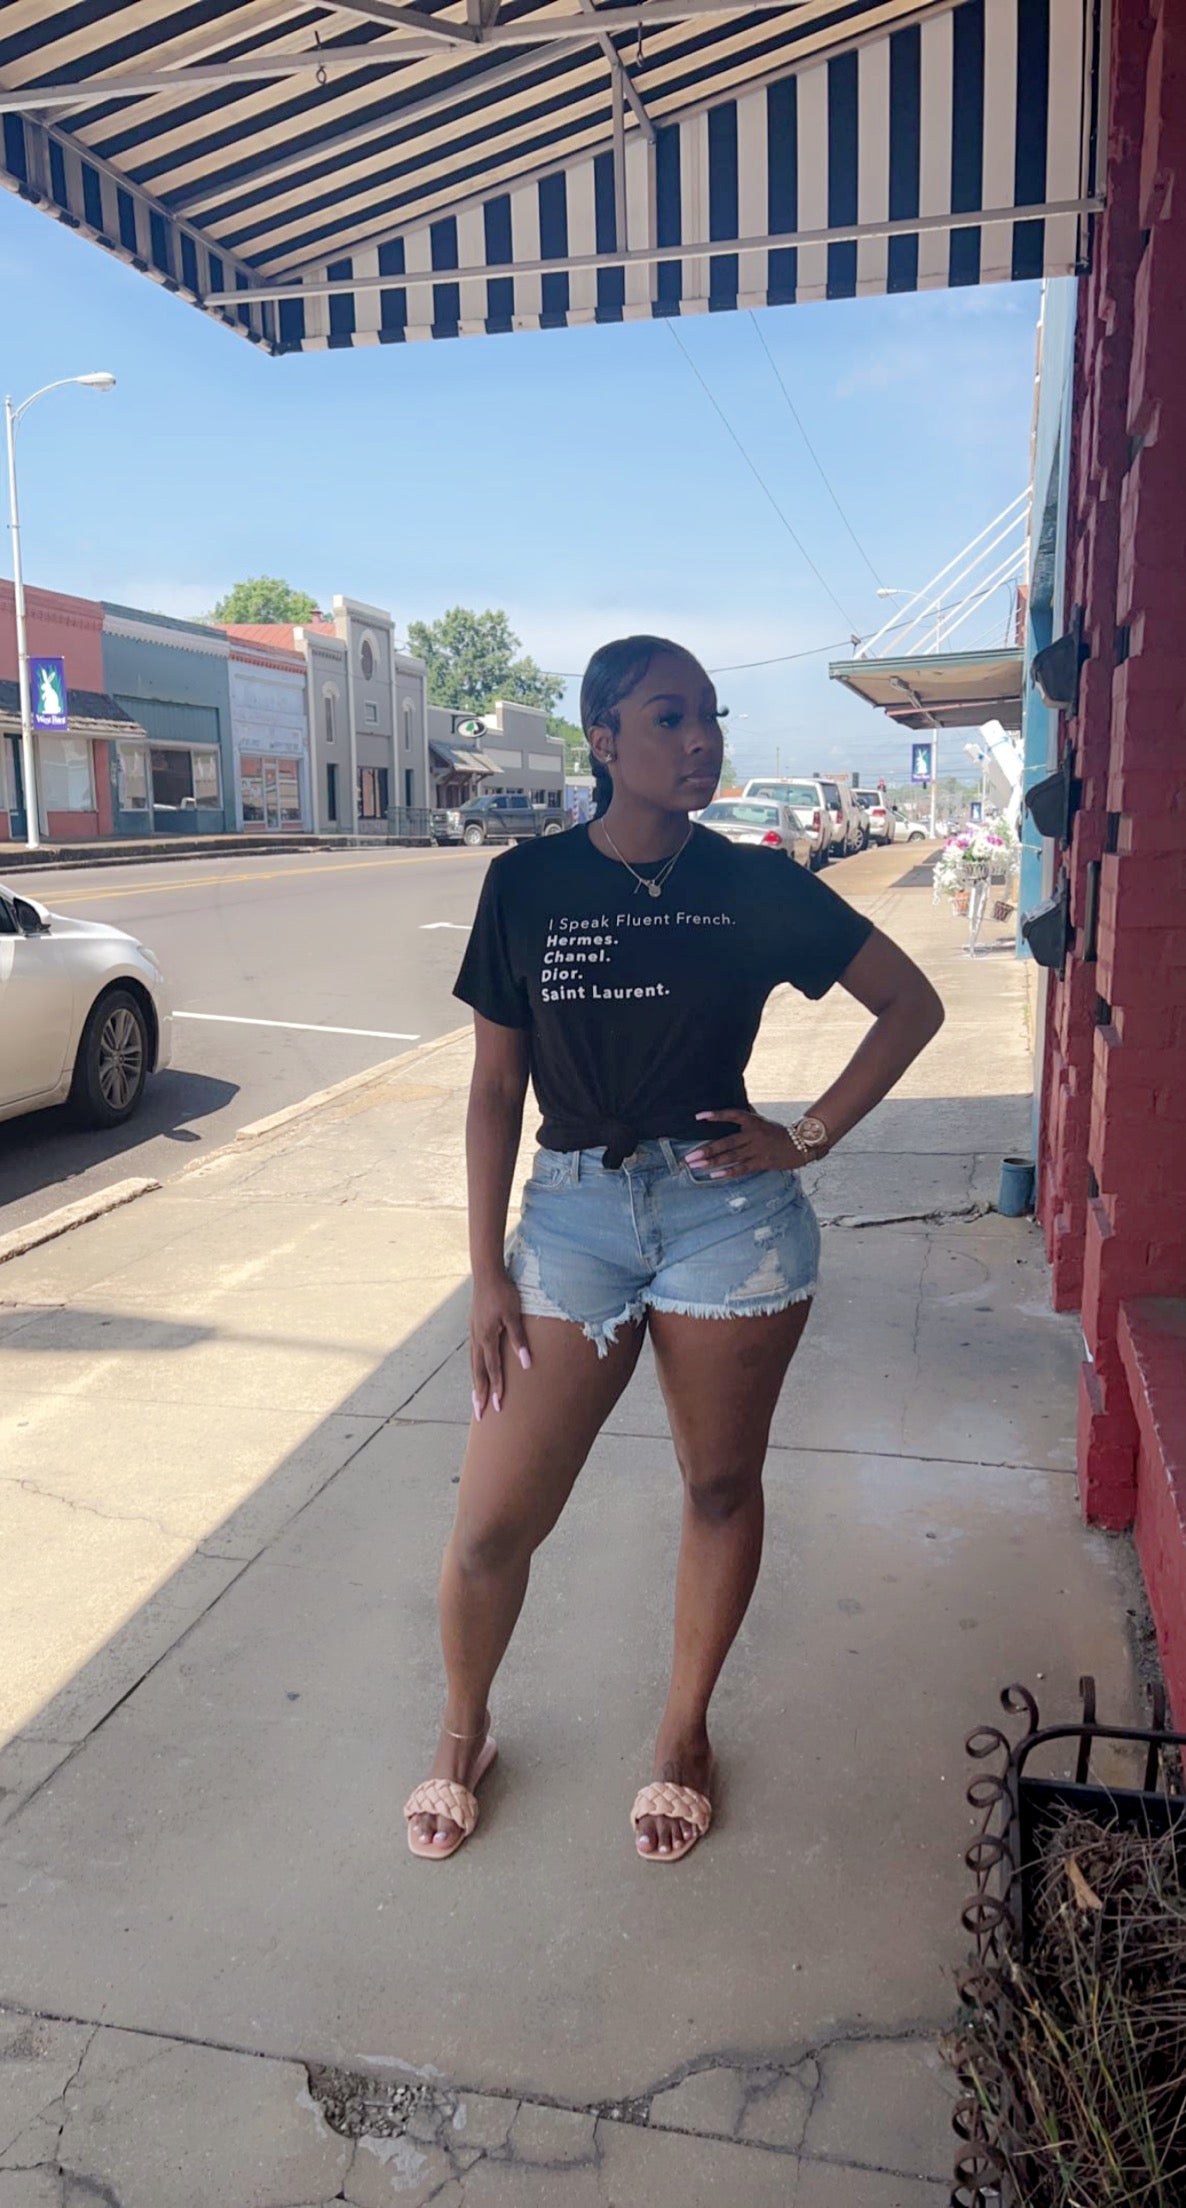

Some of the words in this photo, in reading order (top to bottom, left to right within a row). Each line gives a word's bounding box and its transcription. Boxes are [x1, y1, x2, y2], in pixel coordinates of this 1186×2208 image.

[549, 919, 553, 930] I
[560, 915, 608, 932] Speak
[617, 914, 669, 926] Fluent
[677, 912, 735, 925] French.
[547, 935, 618, 947] Hermes.
[544, 949, 610, 964] Chanel.
[541, 968, 582, 982] Dior.
[542, 985, 585, 1002] Saint
[593, 983, 669, 999] Laurent.
